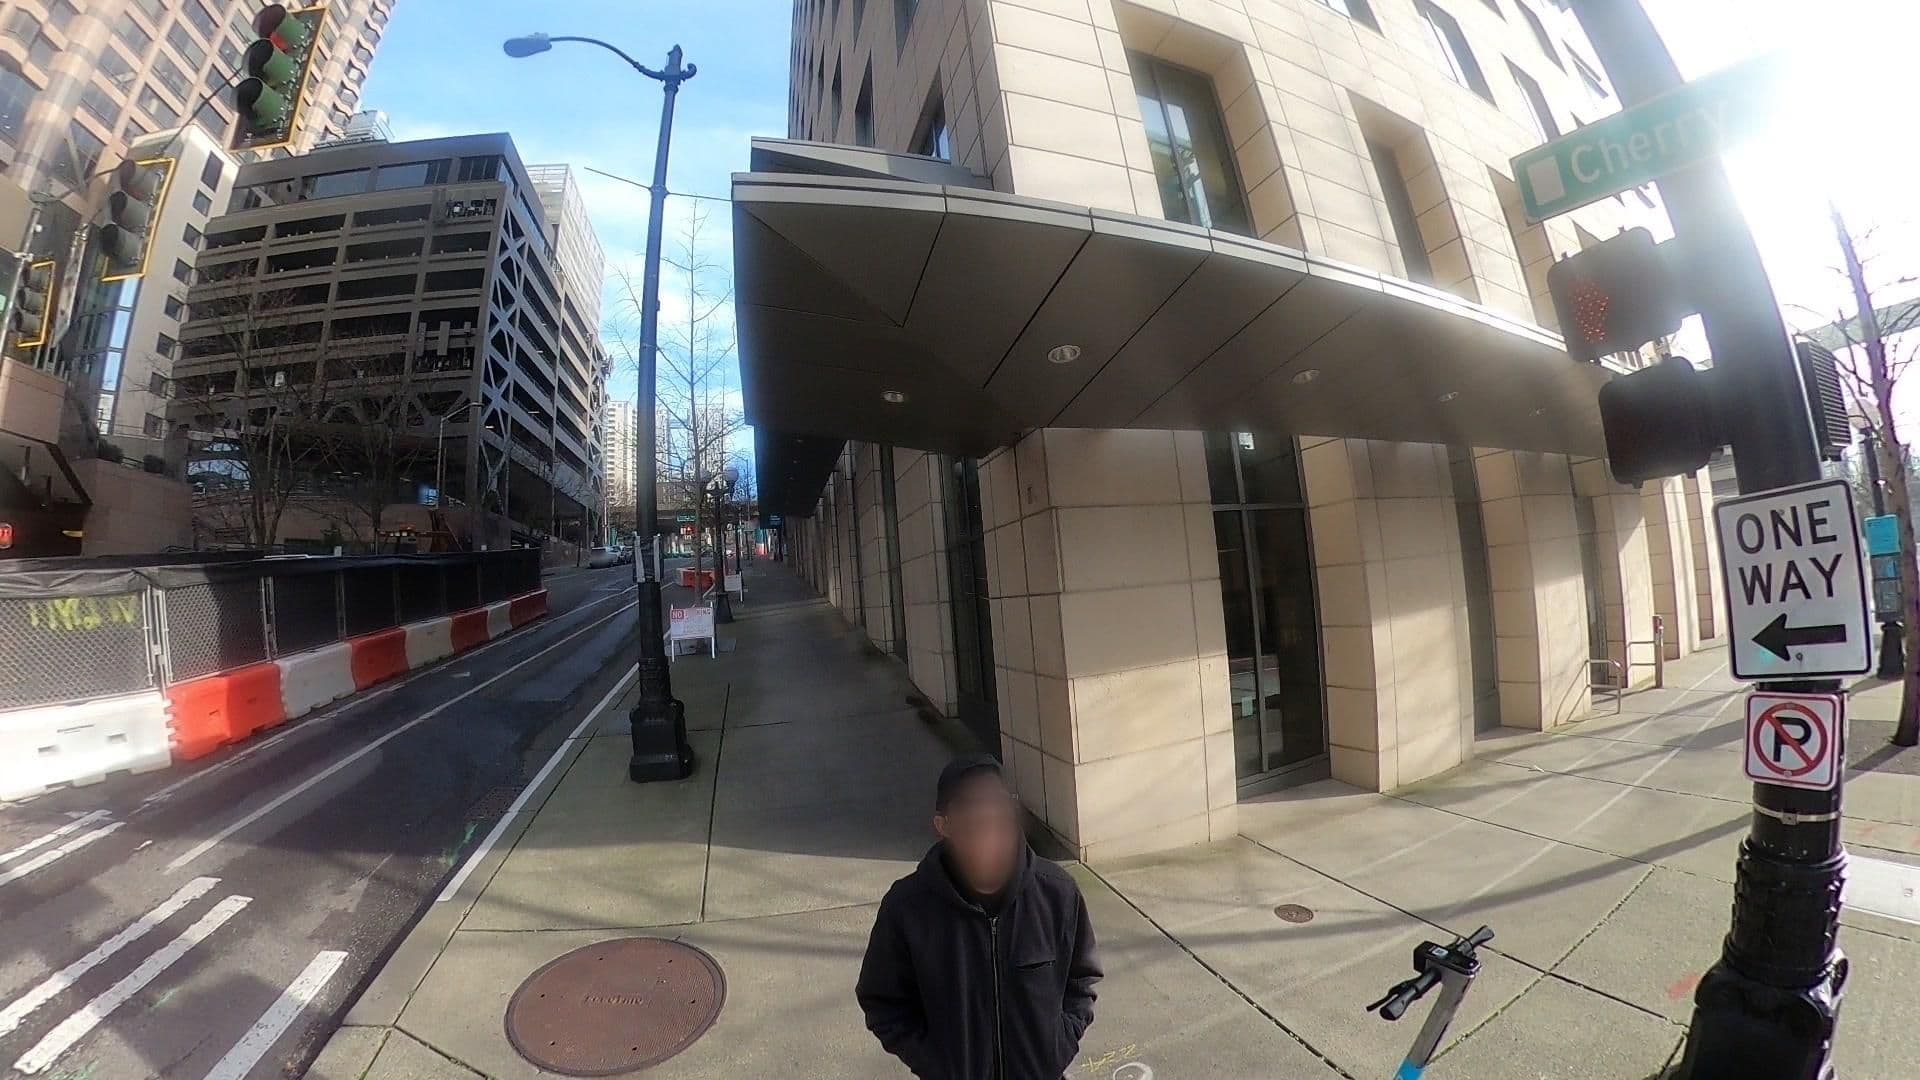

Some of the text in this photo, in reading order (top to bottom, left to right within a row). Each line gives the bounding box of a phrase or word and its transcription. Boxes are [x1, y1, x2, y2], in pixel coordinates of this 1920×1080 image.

[1571, 100, 1731, 184] Cherry
[1736, 500, 1837, 555] ONE
[1738, 553, 1843, 606] WAY
[672, 610, 683, 619] NO
[1772, 716, 1812, 763] P
